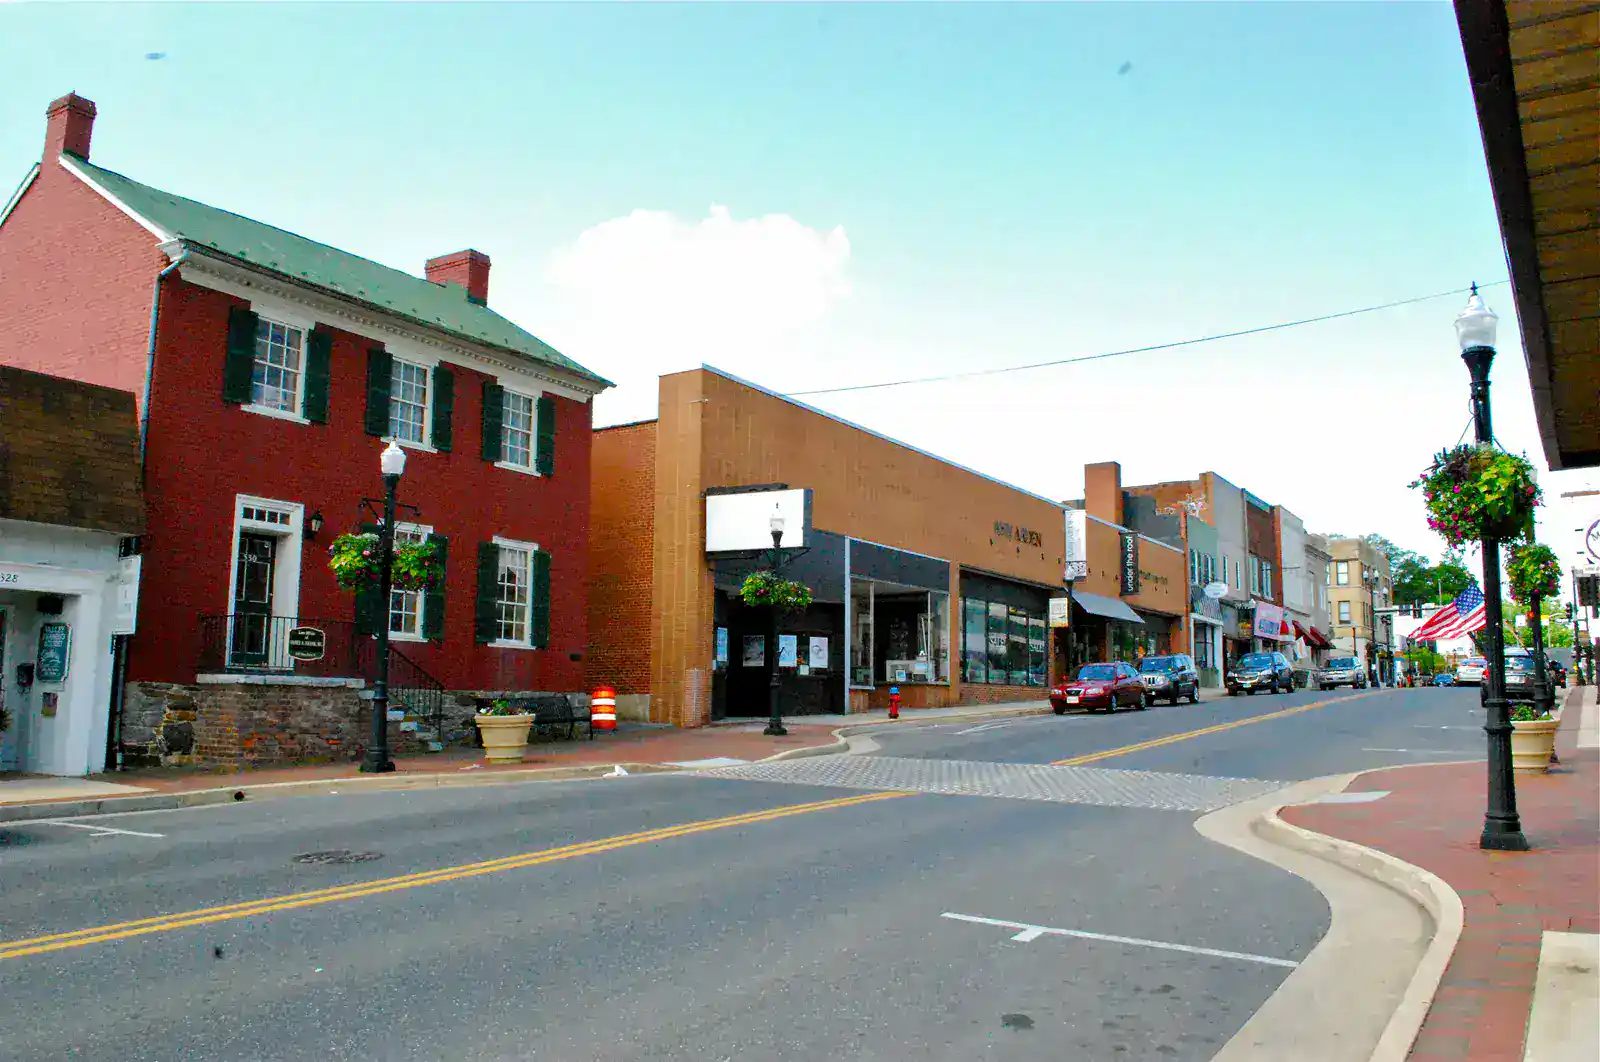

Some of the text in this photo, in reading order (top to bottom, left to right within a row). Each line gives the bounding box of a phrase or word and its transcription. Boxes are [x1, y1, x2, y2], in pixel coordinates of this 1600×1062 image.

[1125, 536, 1134, 592] under the roof
